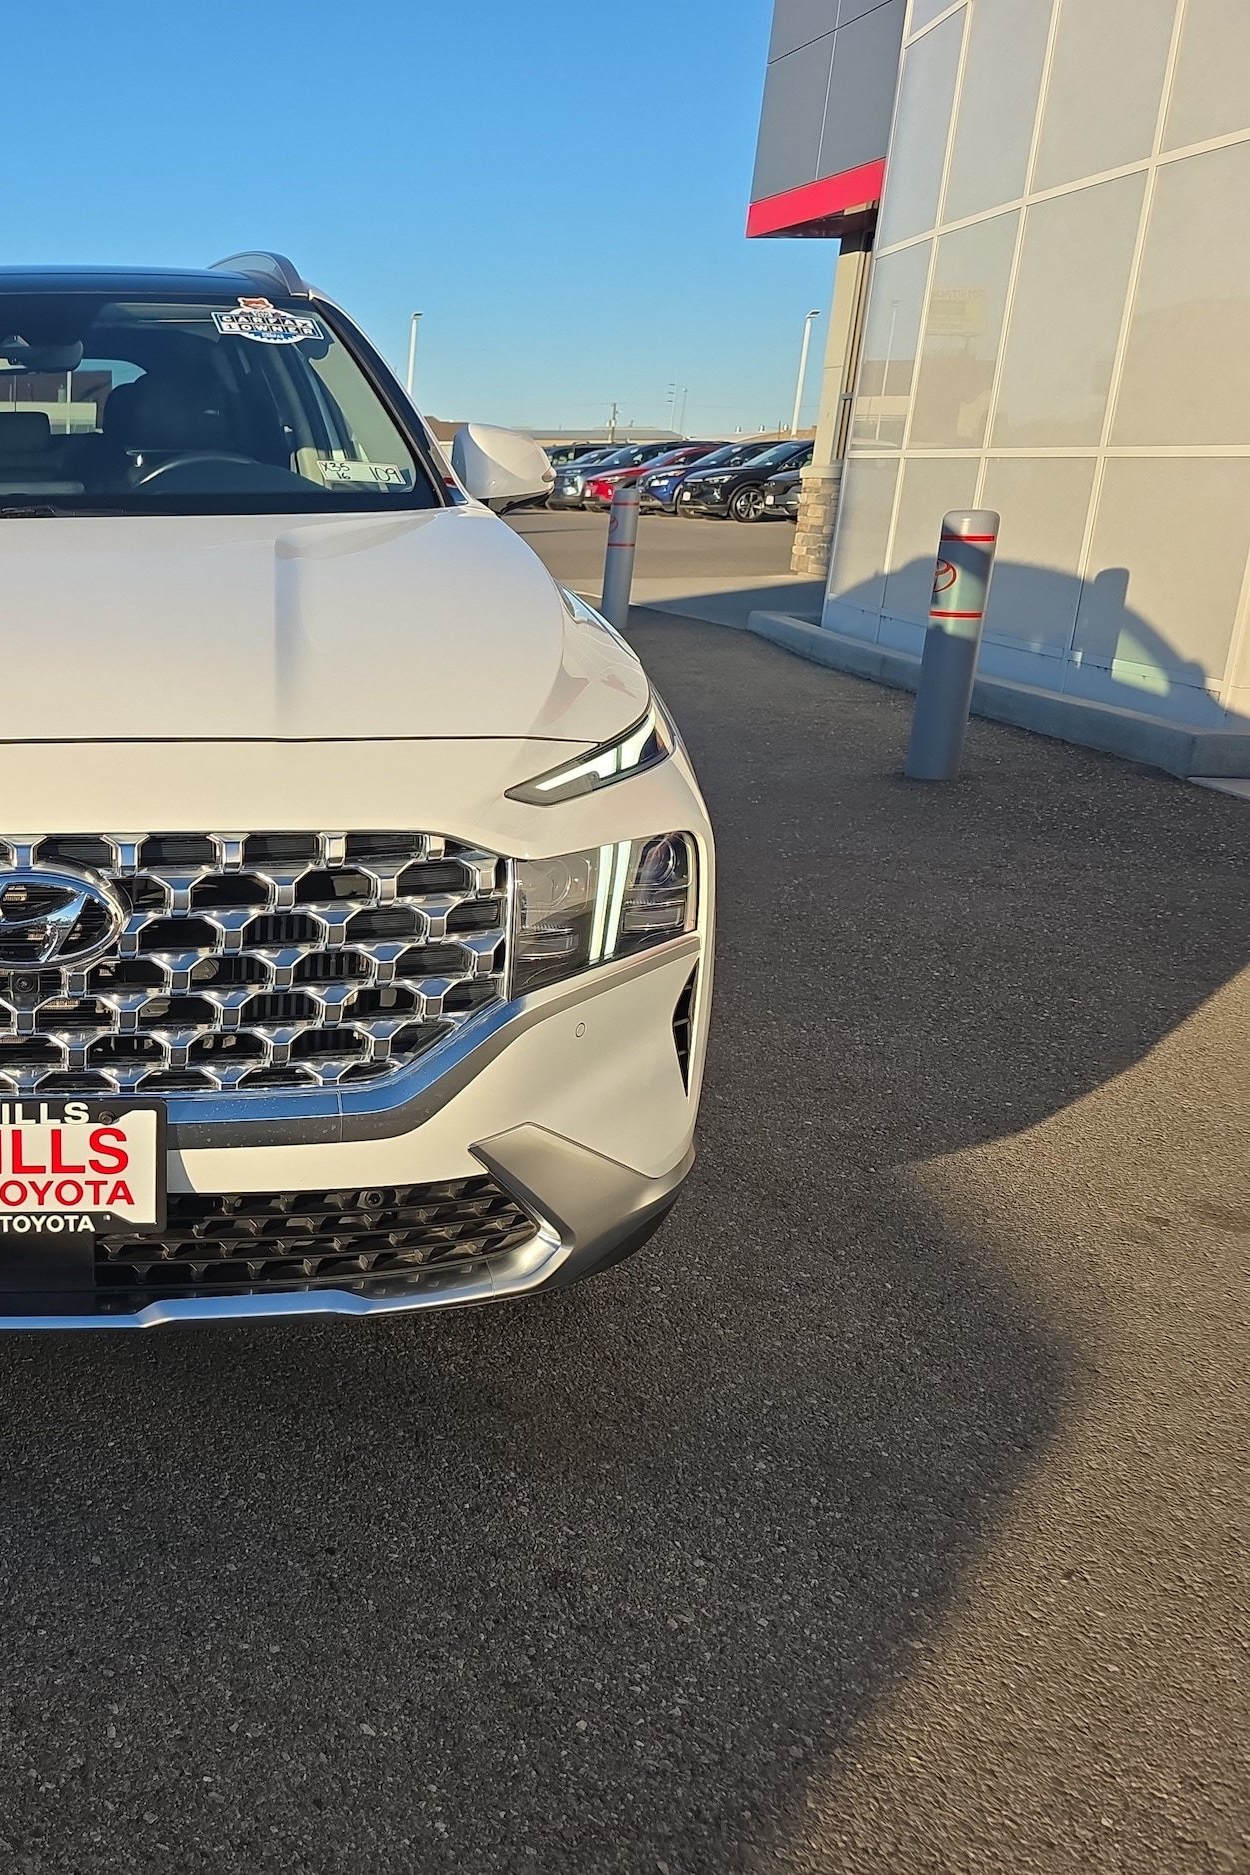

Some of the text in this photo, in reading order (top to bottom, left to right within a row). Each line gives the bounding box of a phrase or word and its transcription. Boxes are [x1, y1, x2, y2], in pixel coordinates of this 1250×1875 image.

[221, 315, 314, 329] CARFAX
[240, 324, 314, 335] OWNER
[369, 466, 402, 483] 109
[0, 1215, 96, 1233] TOYOTA
